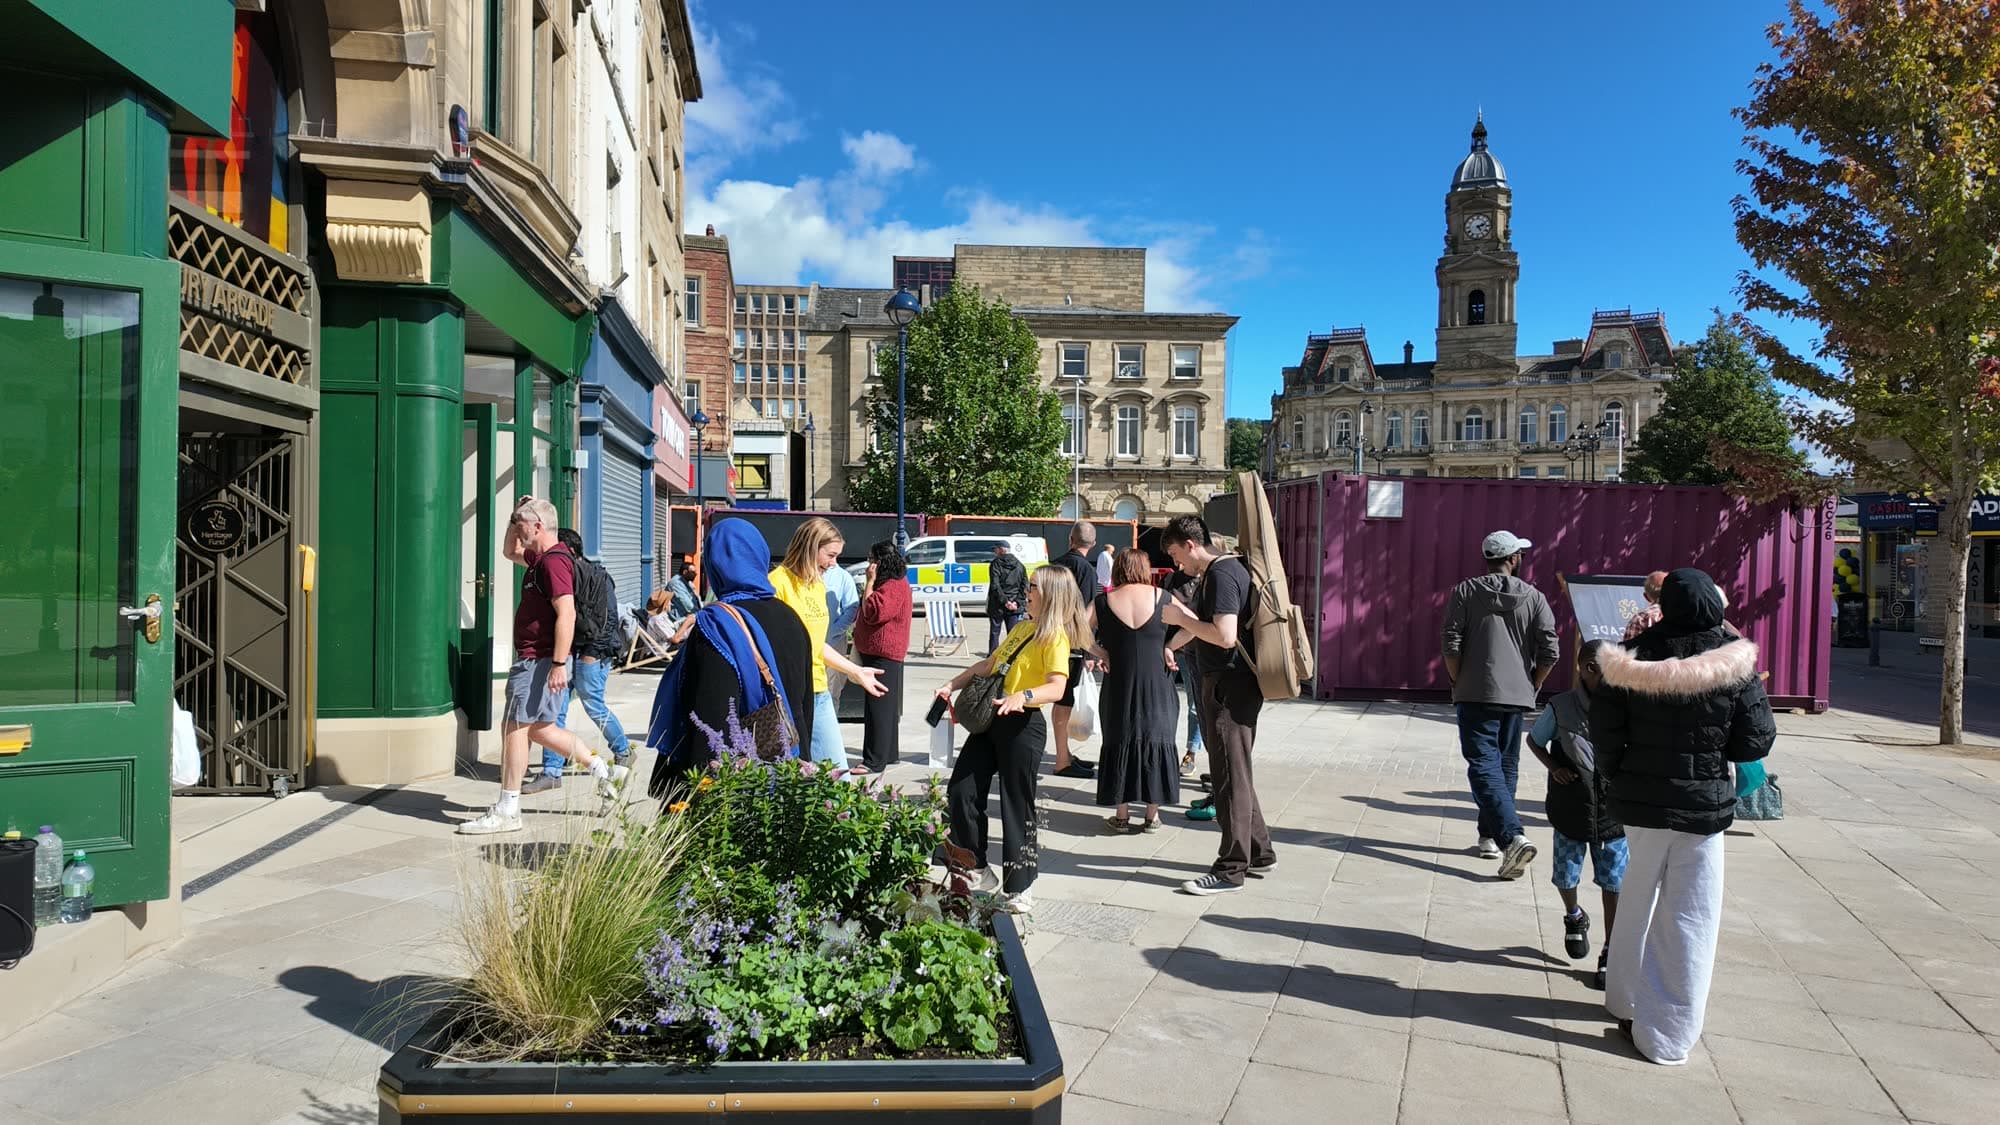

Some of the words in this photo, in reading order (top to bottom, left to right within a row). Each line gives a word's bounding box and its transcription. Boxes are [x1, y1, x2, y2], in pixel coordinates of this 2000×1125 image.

[213, 281, 274, 330] ARCADE
[201, 532, 232, 540] Heritage
[910, 585, 983, 594] POLICE
